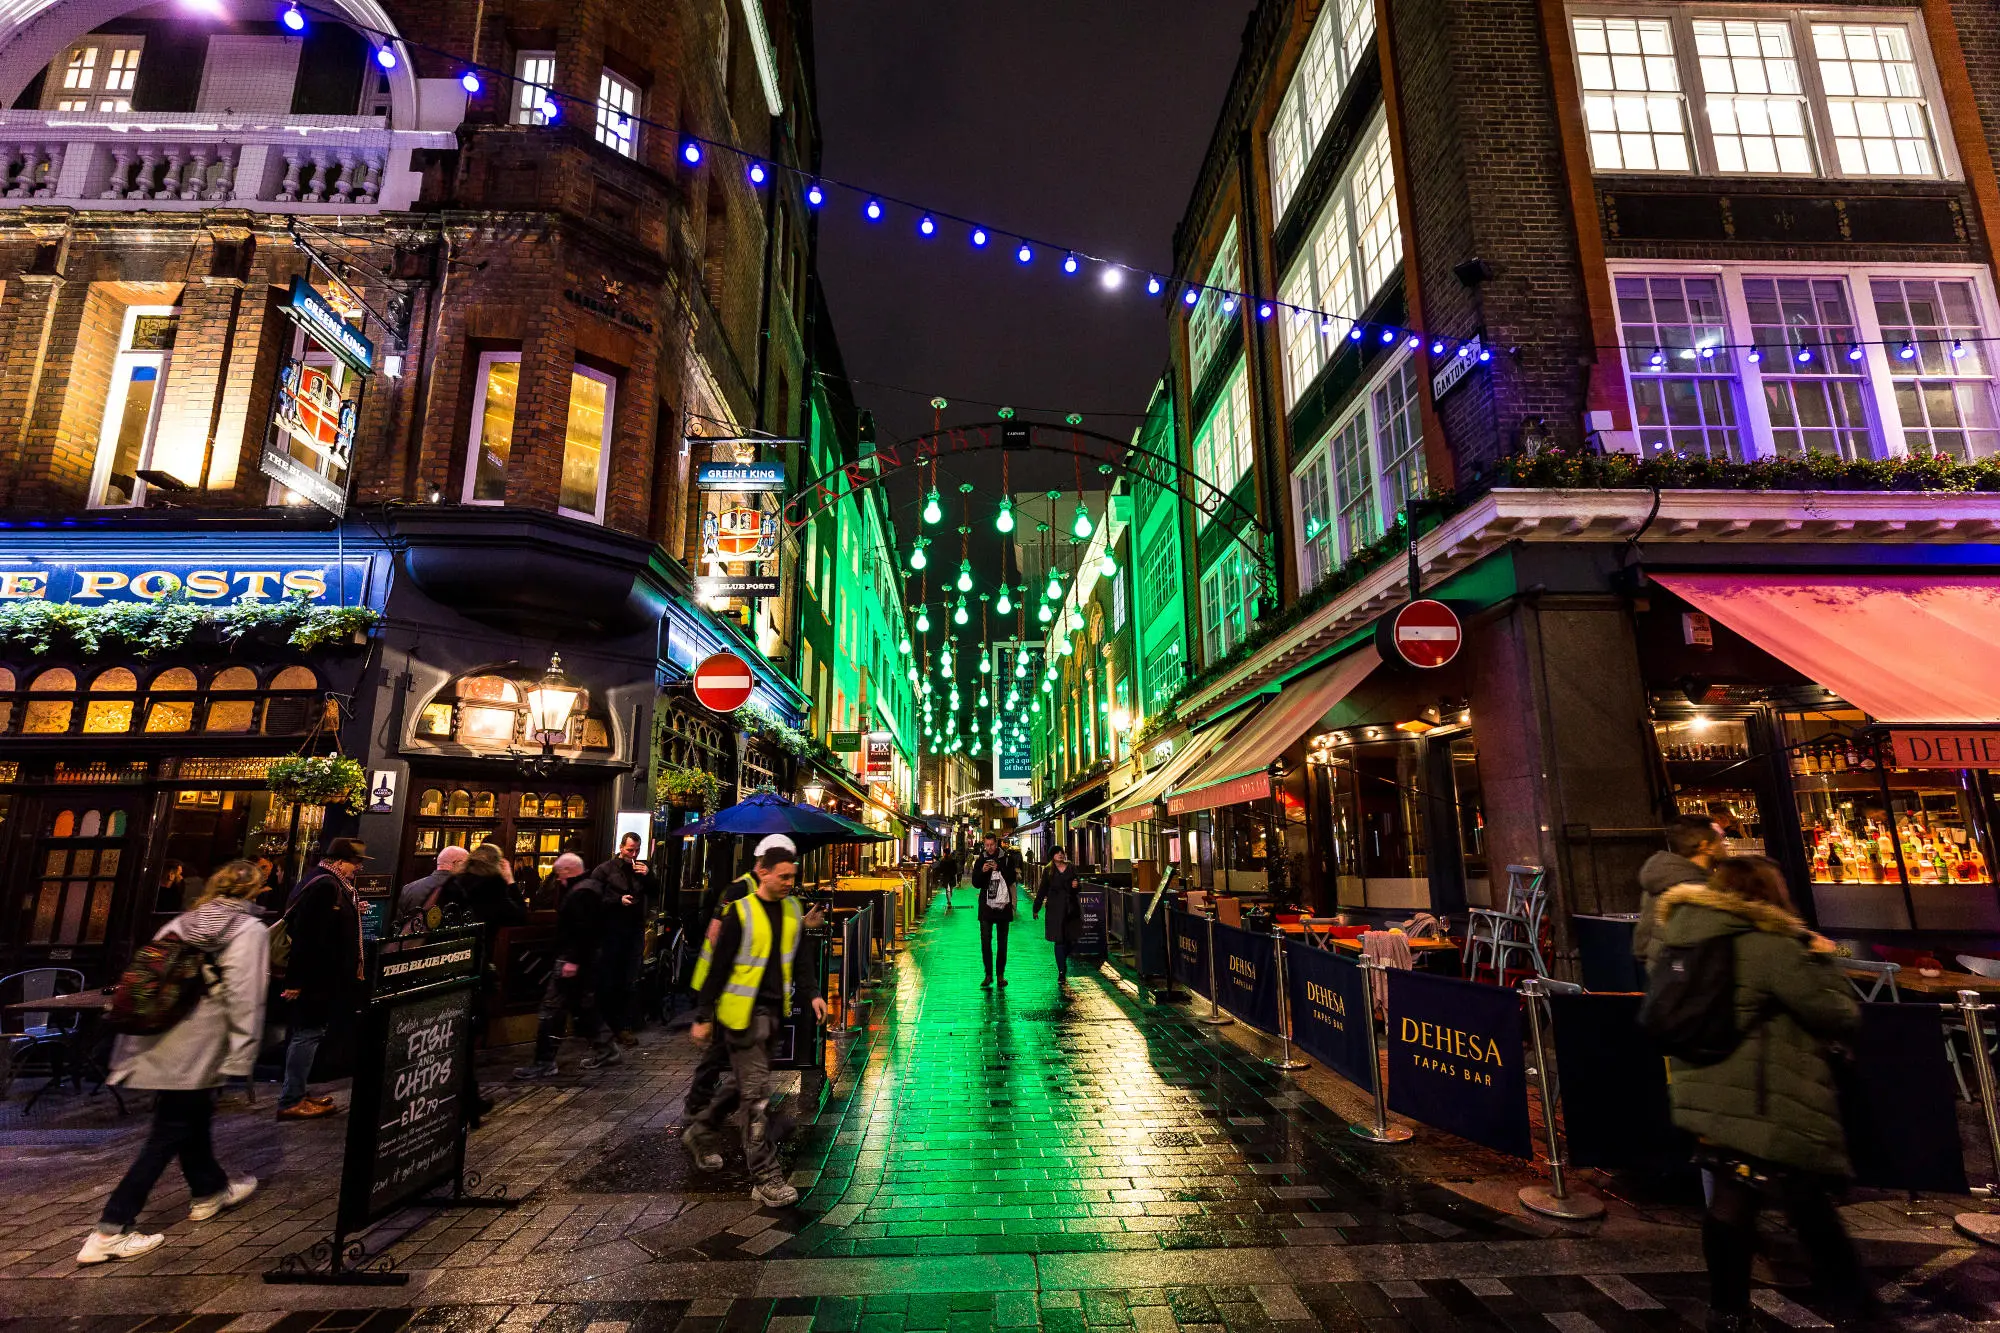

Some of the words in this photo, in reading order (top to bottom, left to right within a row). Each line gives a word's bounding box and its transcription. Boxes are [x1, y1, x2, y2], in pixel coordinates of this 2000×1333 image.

[303, 297, 342, 337] GREENE
[342, 331, 367, 358] KING
[1436, 359, 1465, 397] GANTON
[267, 451, 289, 470] THE
[707, 469, 747, 479] GREENE
[749, 469, 775, 479] KING
[70, 569, 327, 600] POSTS
[871, 743, 889, 752] PIX
[1004, 758, 1015, 766] get
[383, 962, 409, 977] THE
[409, 955, 440, 972] BLUE
[440, 949, 471, 965] POSTS
[1229, 954, 1256, 980] DEHESA
[1306, 980, 1346, 1017] DEHESA
[1313, 1009, 1332, 1024] TAPAS
[1333, 1019, 1344, 1032] BAR
[407, 1019, 454, 1060] FISH
[1401, 1016, 1503, 1067] DEHESA
[418, 1054, 435, 1068] AND
[1413, 1054, 1456, 1076] TAPAS
[1464, 1069, 1491, 1087] BAR
[394, 1057, 453, 1101] CHIPS
[401, 1096, 439, 1127] £12.79
